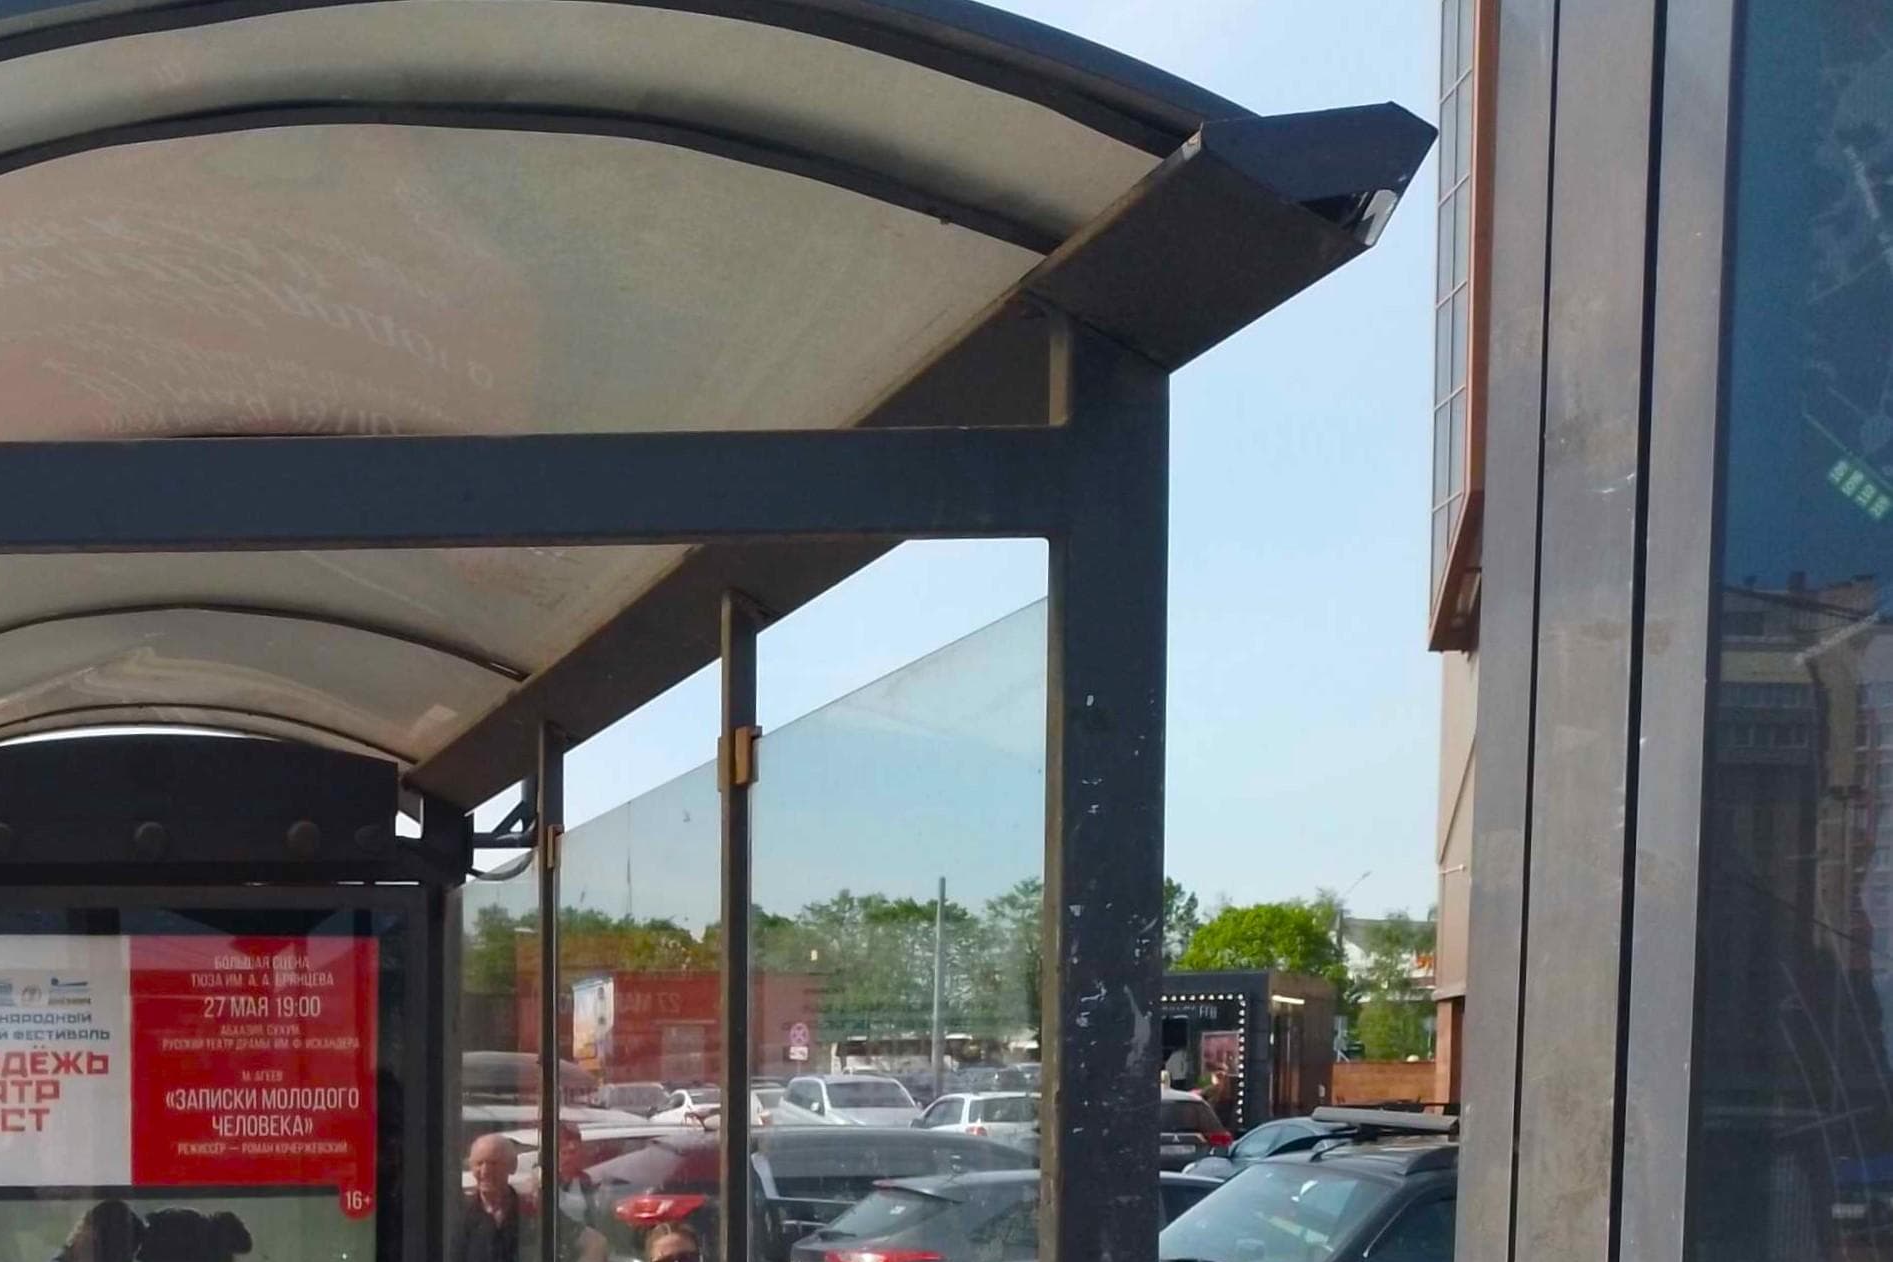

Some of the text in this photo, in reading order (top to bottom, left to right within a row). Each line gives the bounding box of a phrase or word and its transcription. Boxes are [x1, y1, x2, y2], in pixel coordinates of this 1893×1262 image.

[204, 996, 322, 1018] 27 МАЯ 19:00
[13, 1029, 111, 1041] ФЕСТИВАЛЬ
[165, 1088, 359, 1111] «ЗАПИСКИ МОЛОДОГО
[212, 1115, 313, 1136] ЧЕЛОВЕКА»
[346, 1190, 371, 1210] 16+
